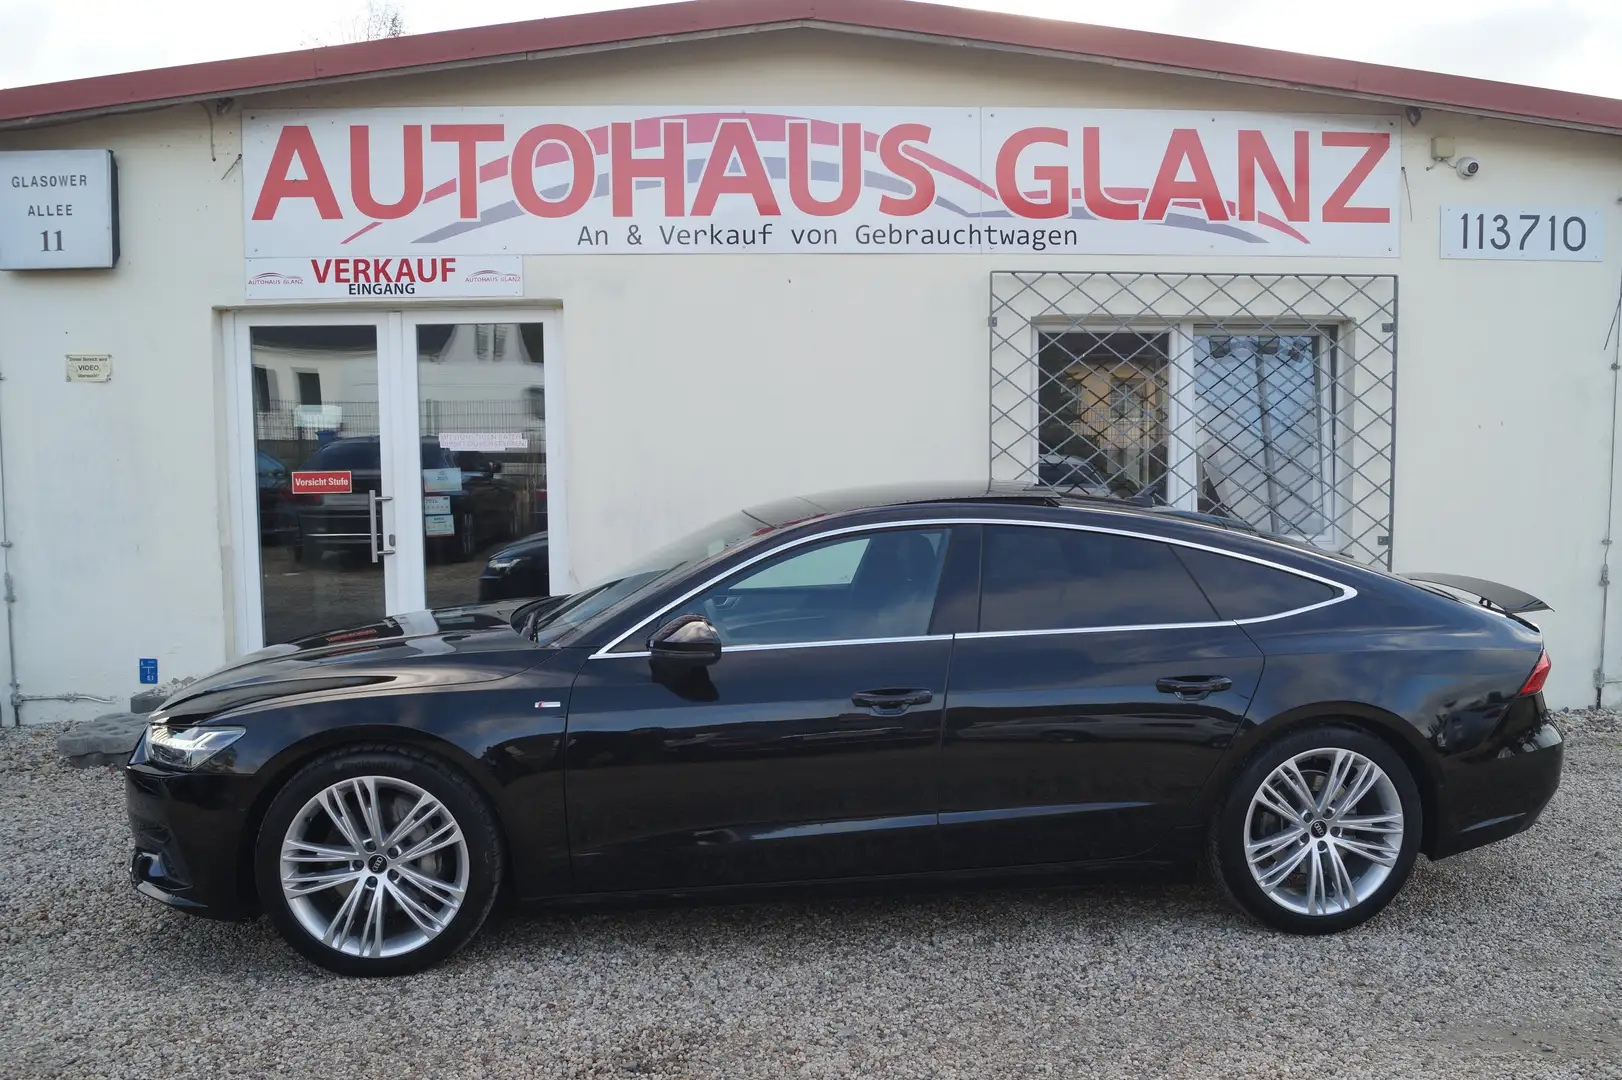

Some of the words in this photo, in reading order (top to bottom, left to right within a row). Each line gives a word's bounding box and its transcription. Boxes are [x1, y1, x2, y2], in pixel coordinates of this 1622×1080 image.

[11, 174, 87, 188] GLASOWER
[252, 121, 936, 221] AUTOHAUS
[994, 126, 1391, 223] GLANZ
[27, 204, 73, 217] ALLEE
[40, 229, 65, 252] 11
[577, 225, 608, 246] An
[626, 224, 643, 246] &
[659, 223, 773, 246] Verkauf
[790, 229, 837, 245] von
[855, 223, 1078, 252] Gebrauchtwagen
[1459, 212, 1587, 252] 113710
[311, 257, 456, 283] VERKAUF
[348, 283, 415, 295] EINGANG
[295, 477, 327, 486] Vorsicht
[328, 477, 349, 486] Stufe
